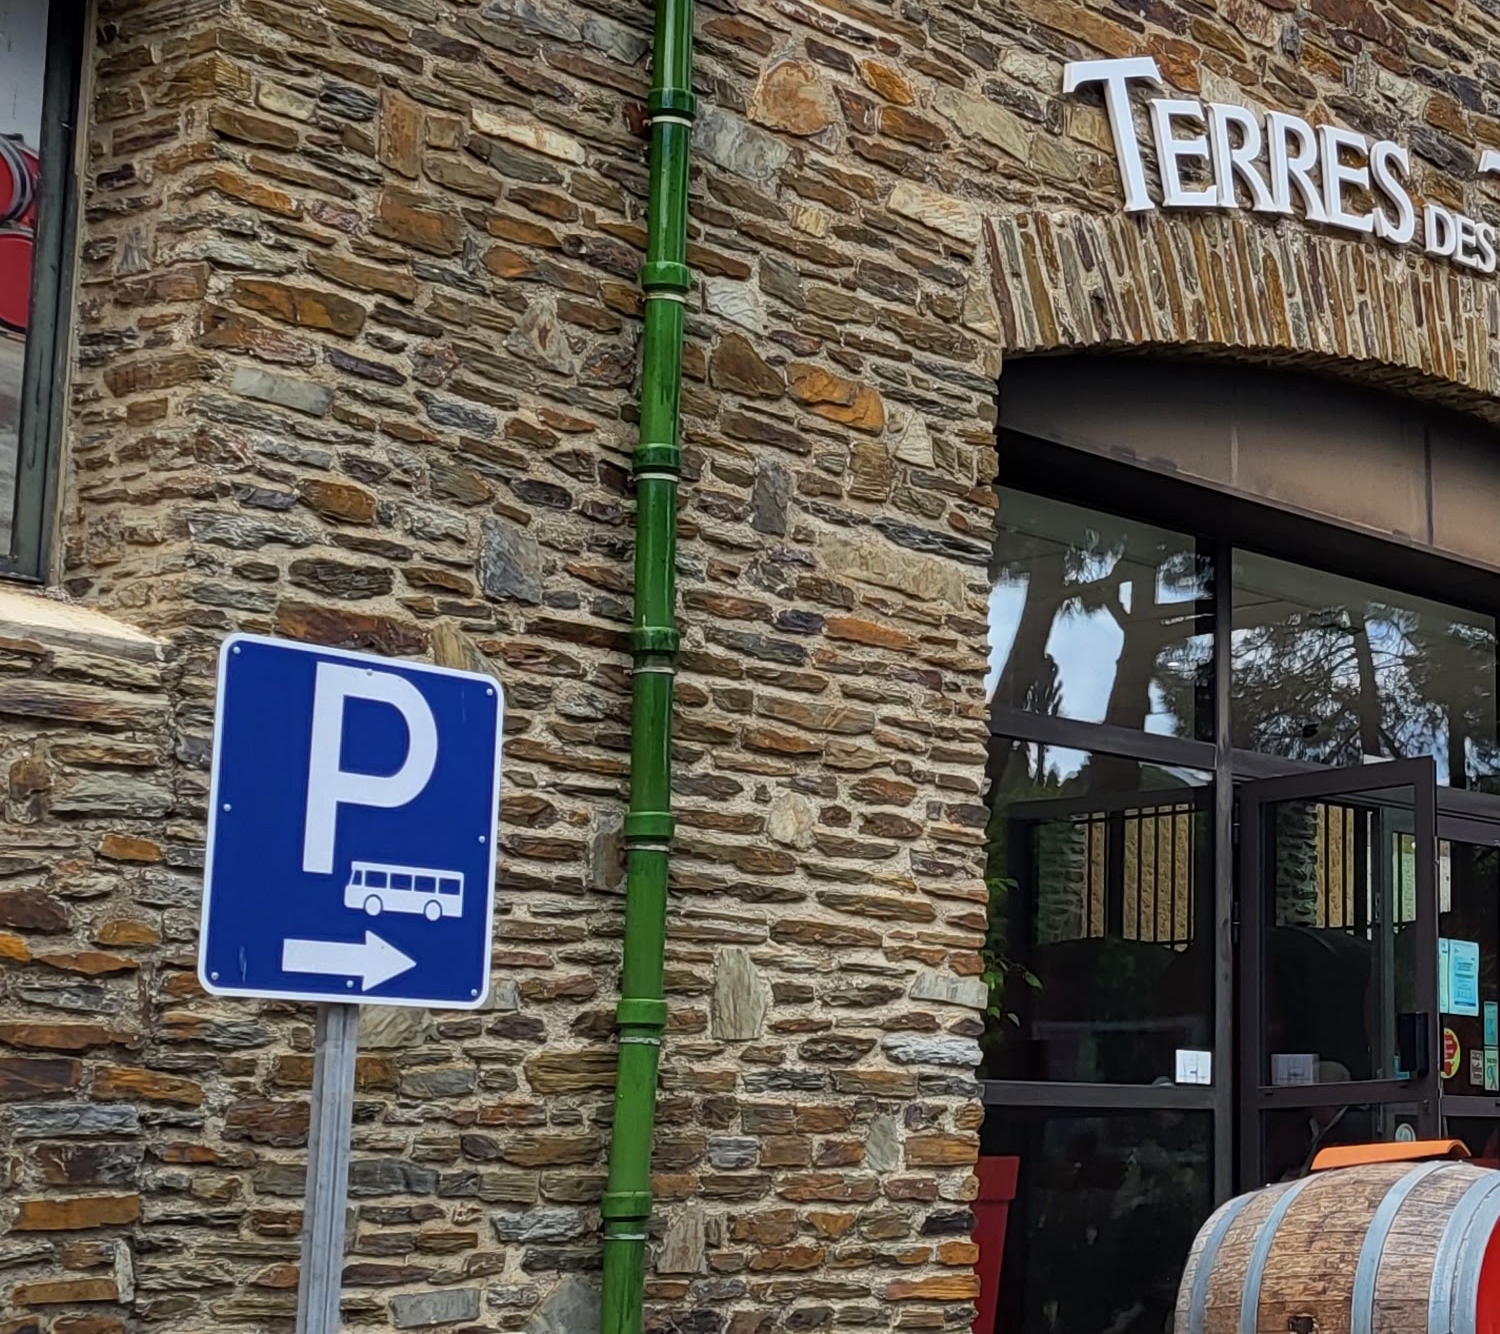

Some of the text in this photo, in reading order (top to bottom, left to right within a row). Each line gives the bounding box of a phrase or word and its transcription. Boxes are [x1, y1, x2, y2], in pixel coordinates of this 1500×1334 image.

[1063, 57, 1416, 244] TERRES
[1423, 203, 1497, 273] DES
[302, 661, 439, 874] P
